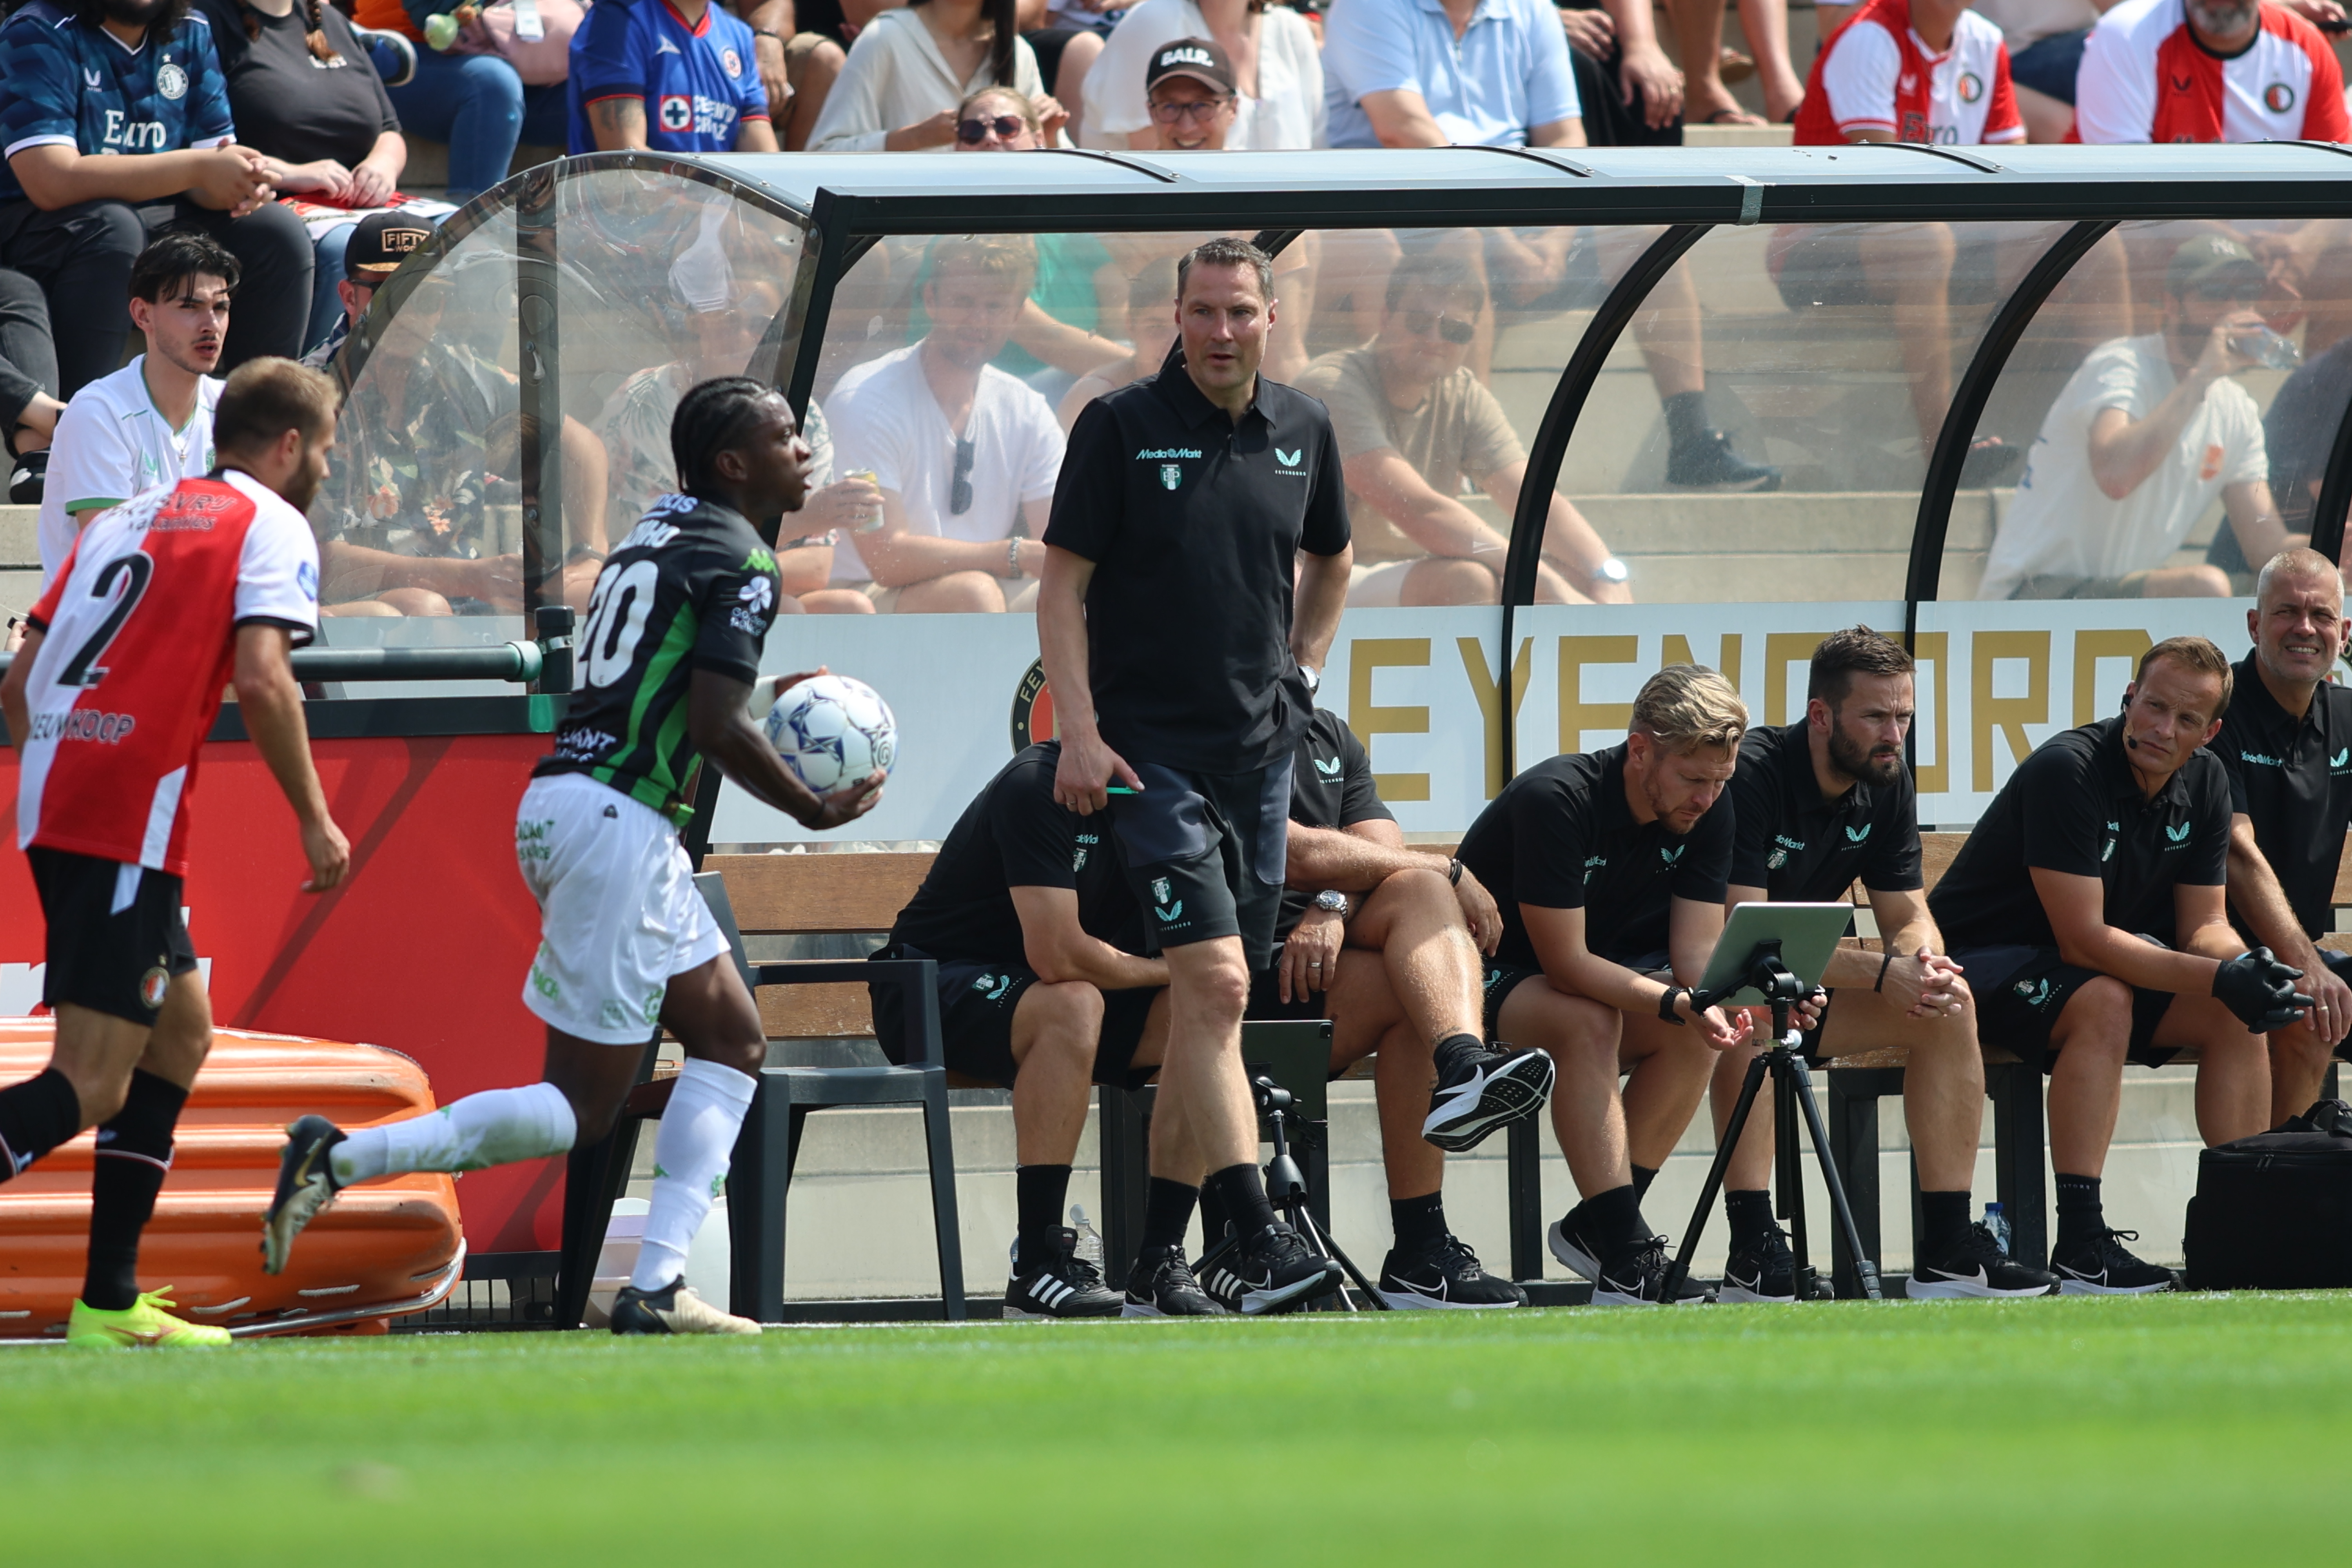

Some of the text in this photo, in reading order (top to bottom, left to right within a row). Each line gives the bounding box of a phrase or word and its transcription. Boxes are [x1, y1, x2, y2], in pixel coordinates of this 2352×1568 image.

[103, 109, 166, 148] Euro
[56, 550, 154, 690] 2
[571, 559, 659, 691] 20
